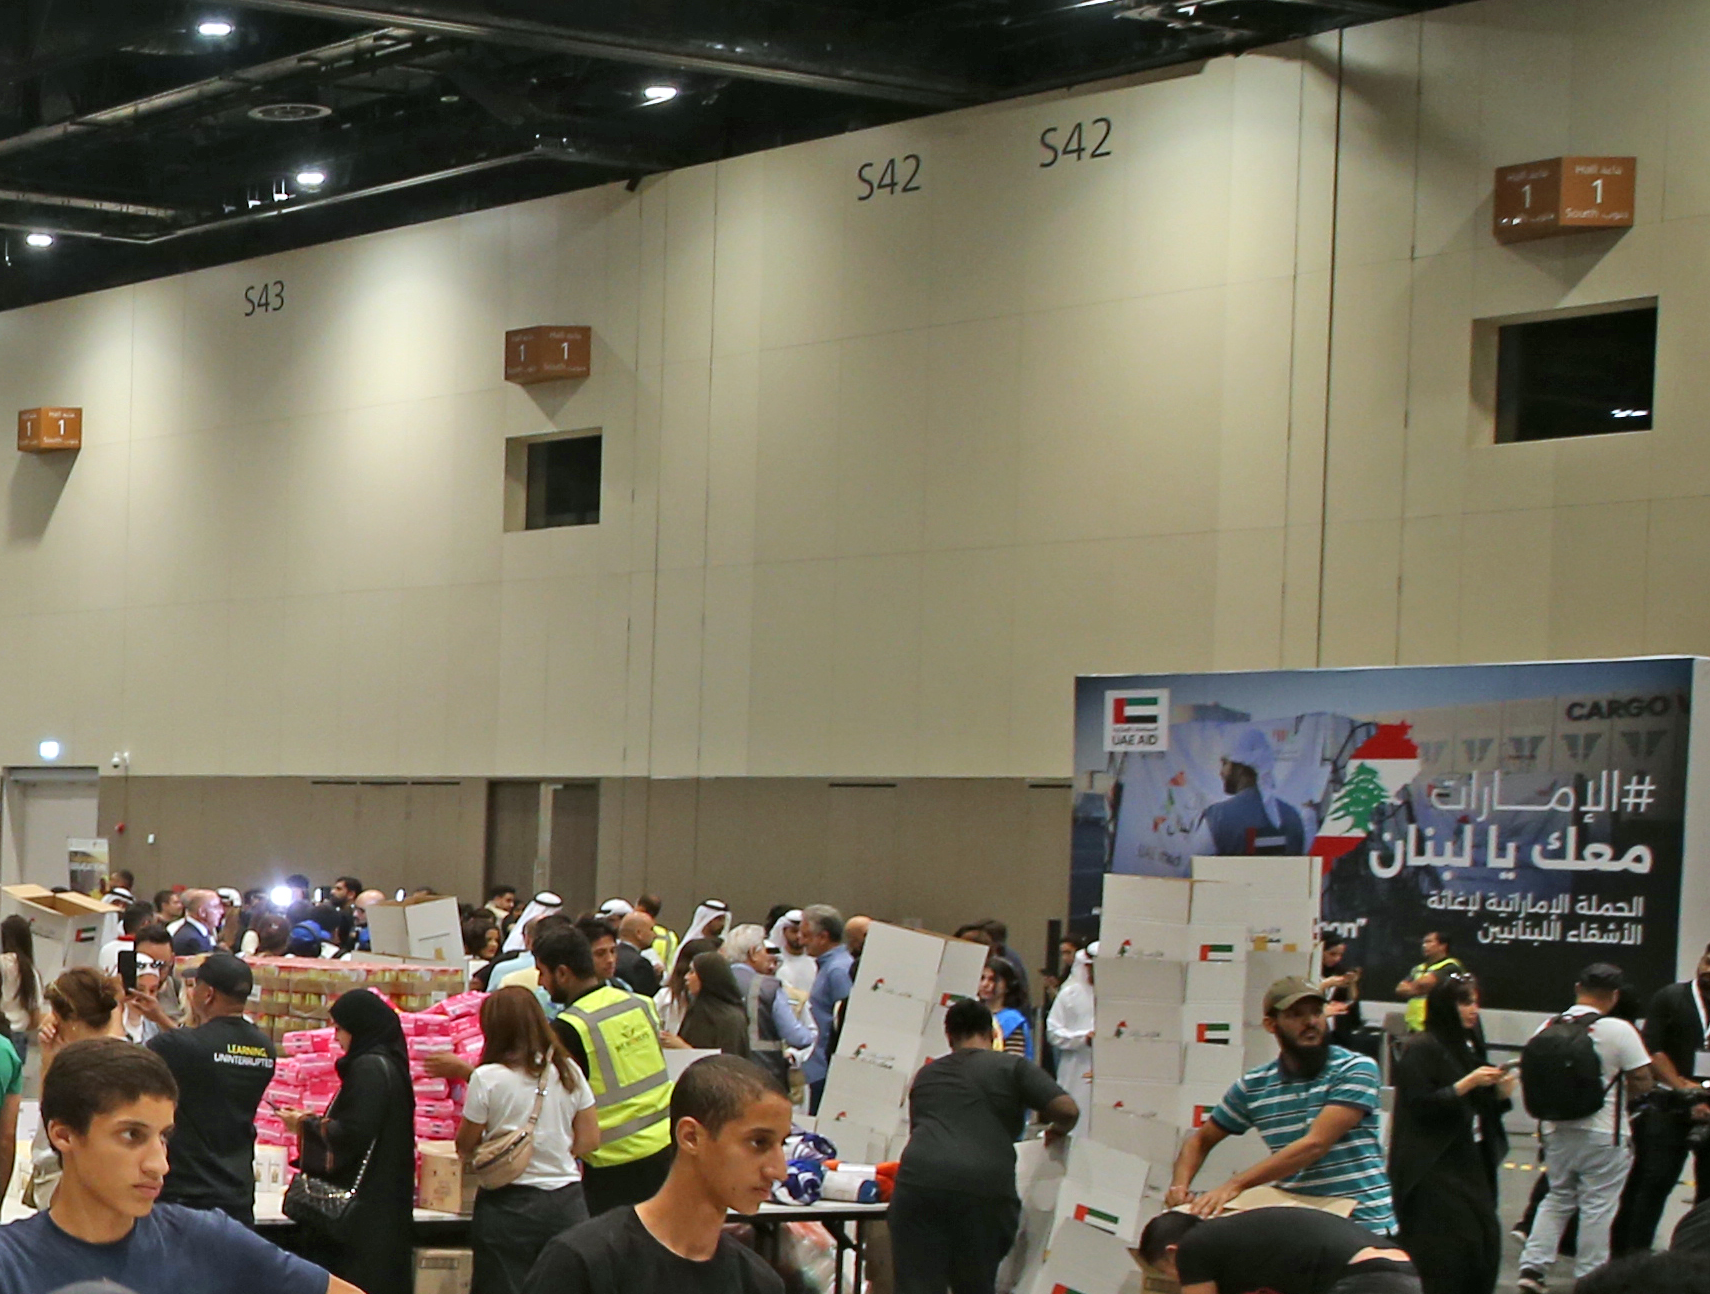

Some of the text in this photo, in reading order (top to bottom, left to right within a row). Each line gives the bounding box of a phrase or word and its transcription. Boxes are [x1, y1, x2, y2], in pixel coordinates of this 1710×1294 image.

[1039, 117, 1113, 168] S42
[856, 154, 923, 201] S42
[1521, 183, 1531, 209] 1
[1591, 178, 1603, 204] 1
[243, 280, 285, 318] S43
[561, 342, 569, 360] 1
[58, 419, 65, 436] 1
[1566, 697, 1669, 722] CARGO
[1111, 733, 1159, 746] UAE AID
[1369, 823, 1654, 880] معك يا لبنان
[1426, 890, 1645, 922] الحملة الإماراتية لإغاثة
[1477, 919, 1644, 947] الأشقاء اللبنانيين
[213, 1052, 274, 1068] UNINTERRUPTED
